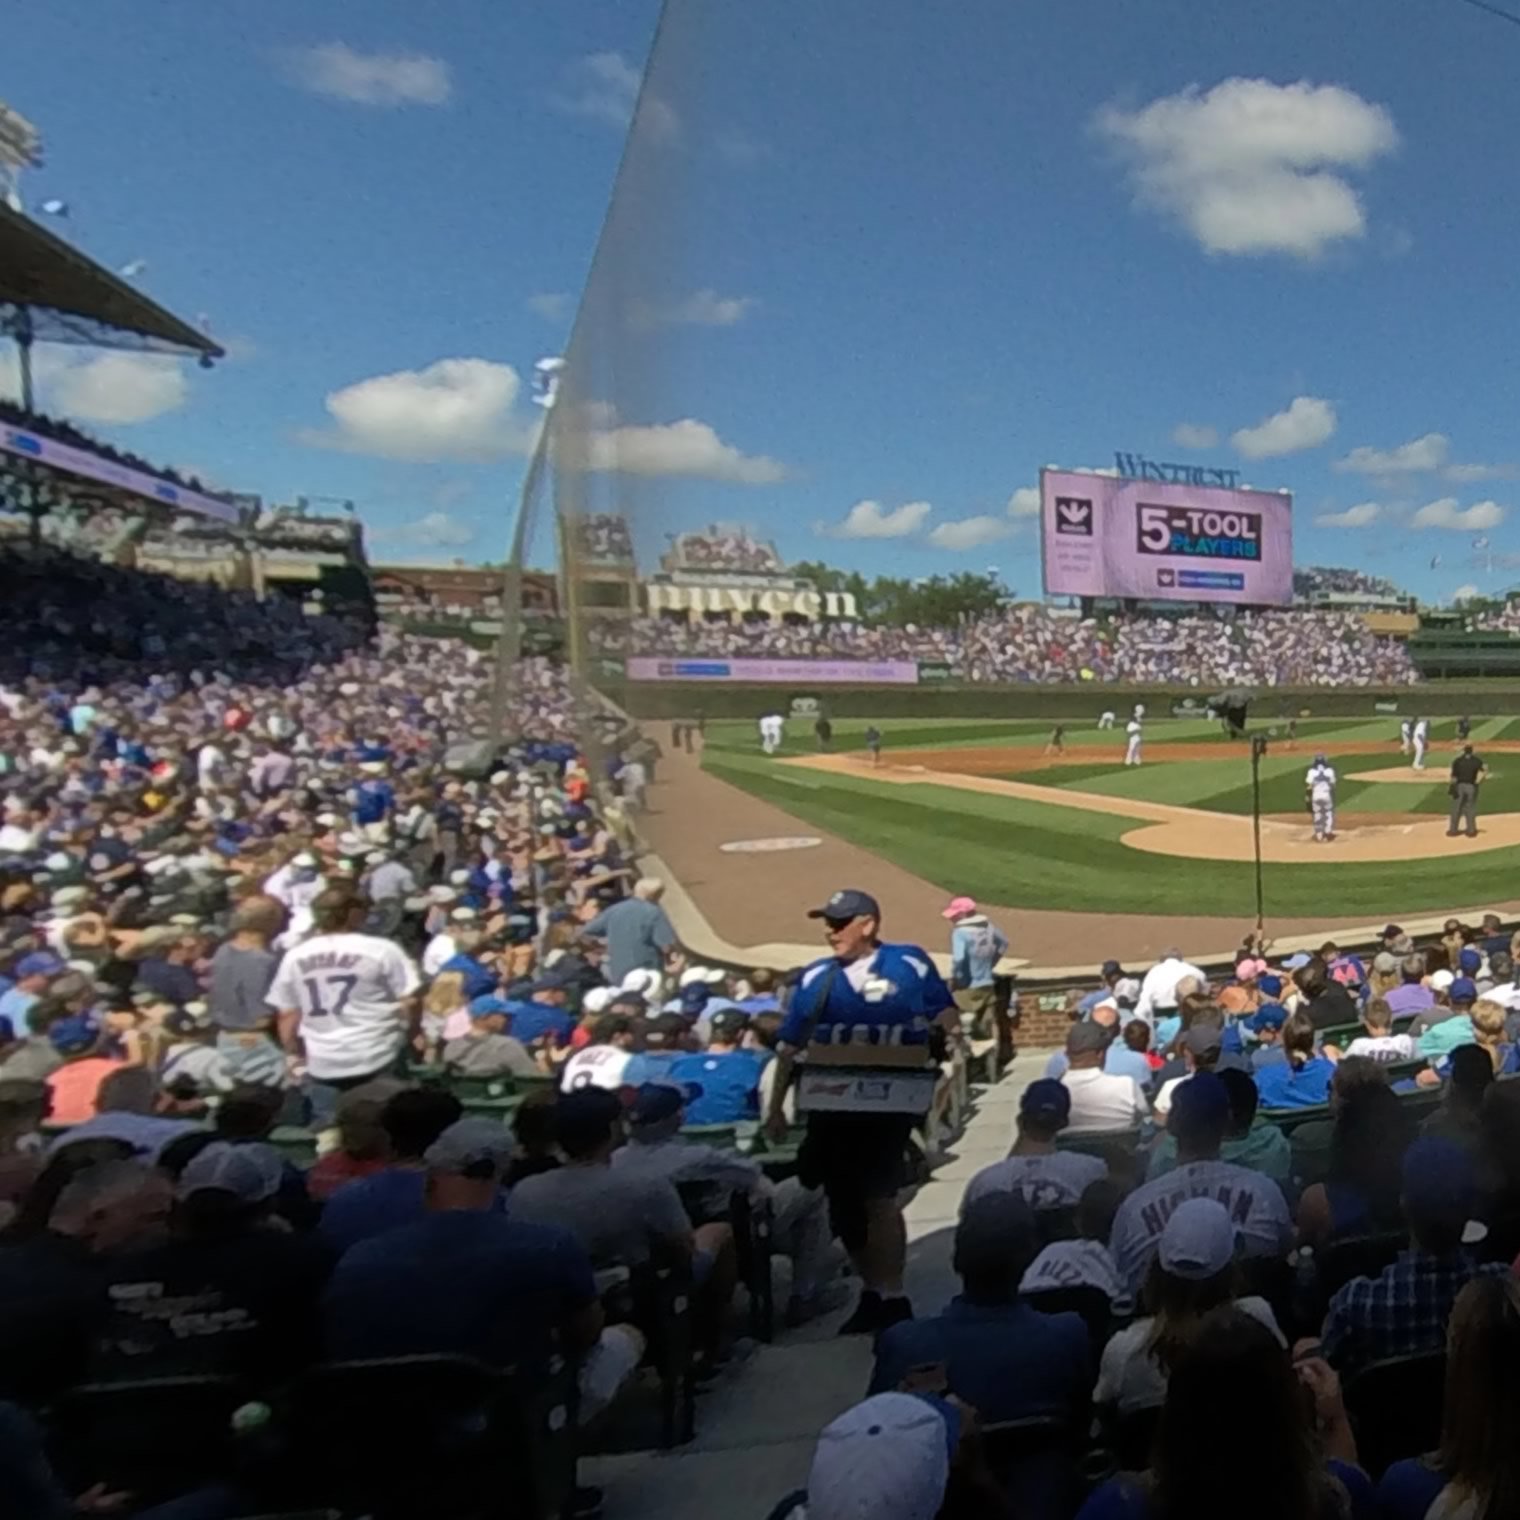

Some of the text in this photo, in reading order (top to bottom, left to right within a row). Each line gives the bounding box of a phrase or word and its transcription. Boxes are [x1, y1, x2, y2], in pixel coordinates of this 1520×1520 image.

[1141, 507, 1257, 551] 5-TOOL
[1171, 531, 1257, 557] PLAYERS
[303, 974, 358, 1016] 17
